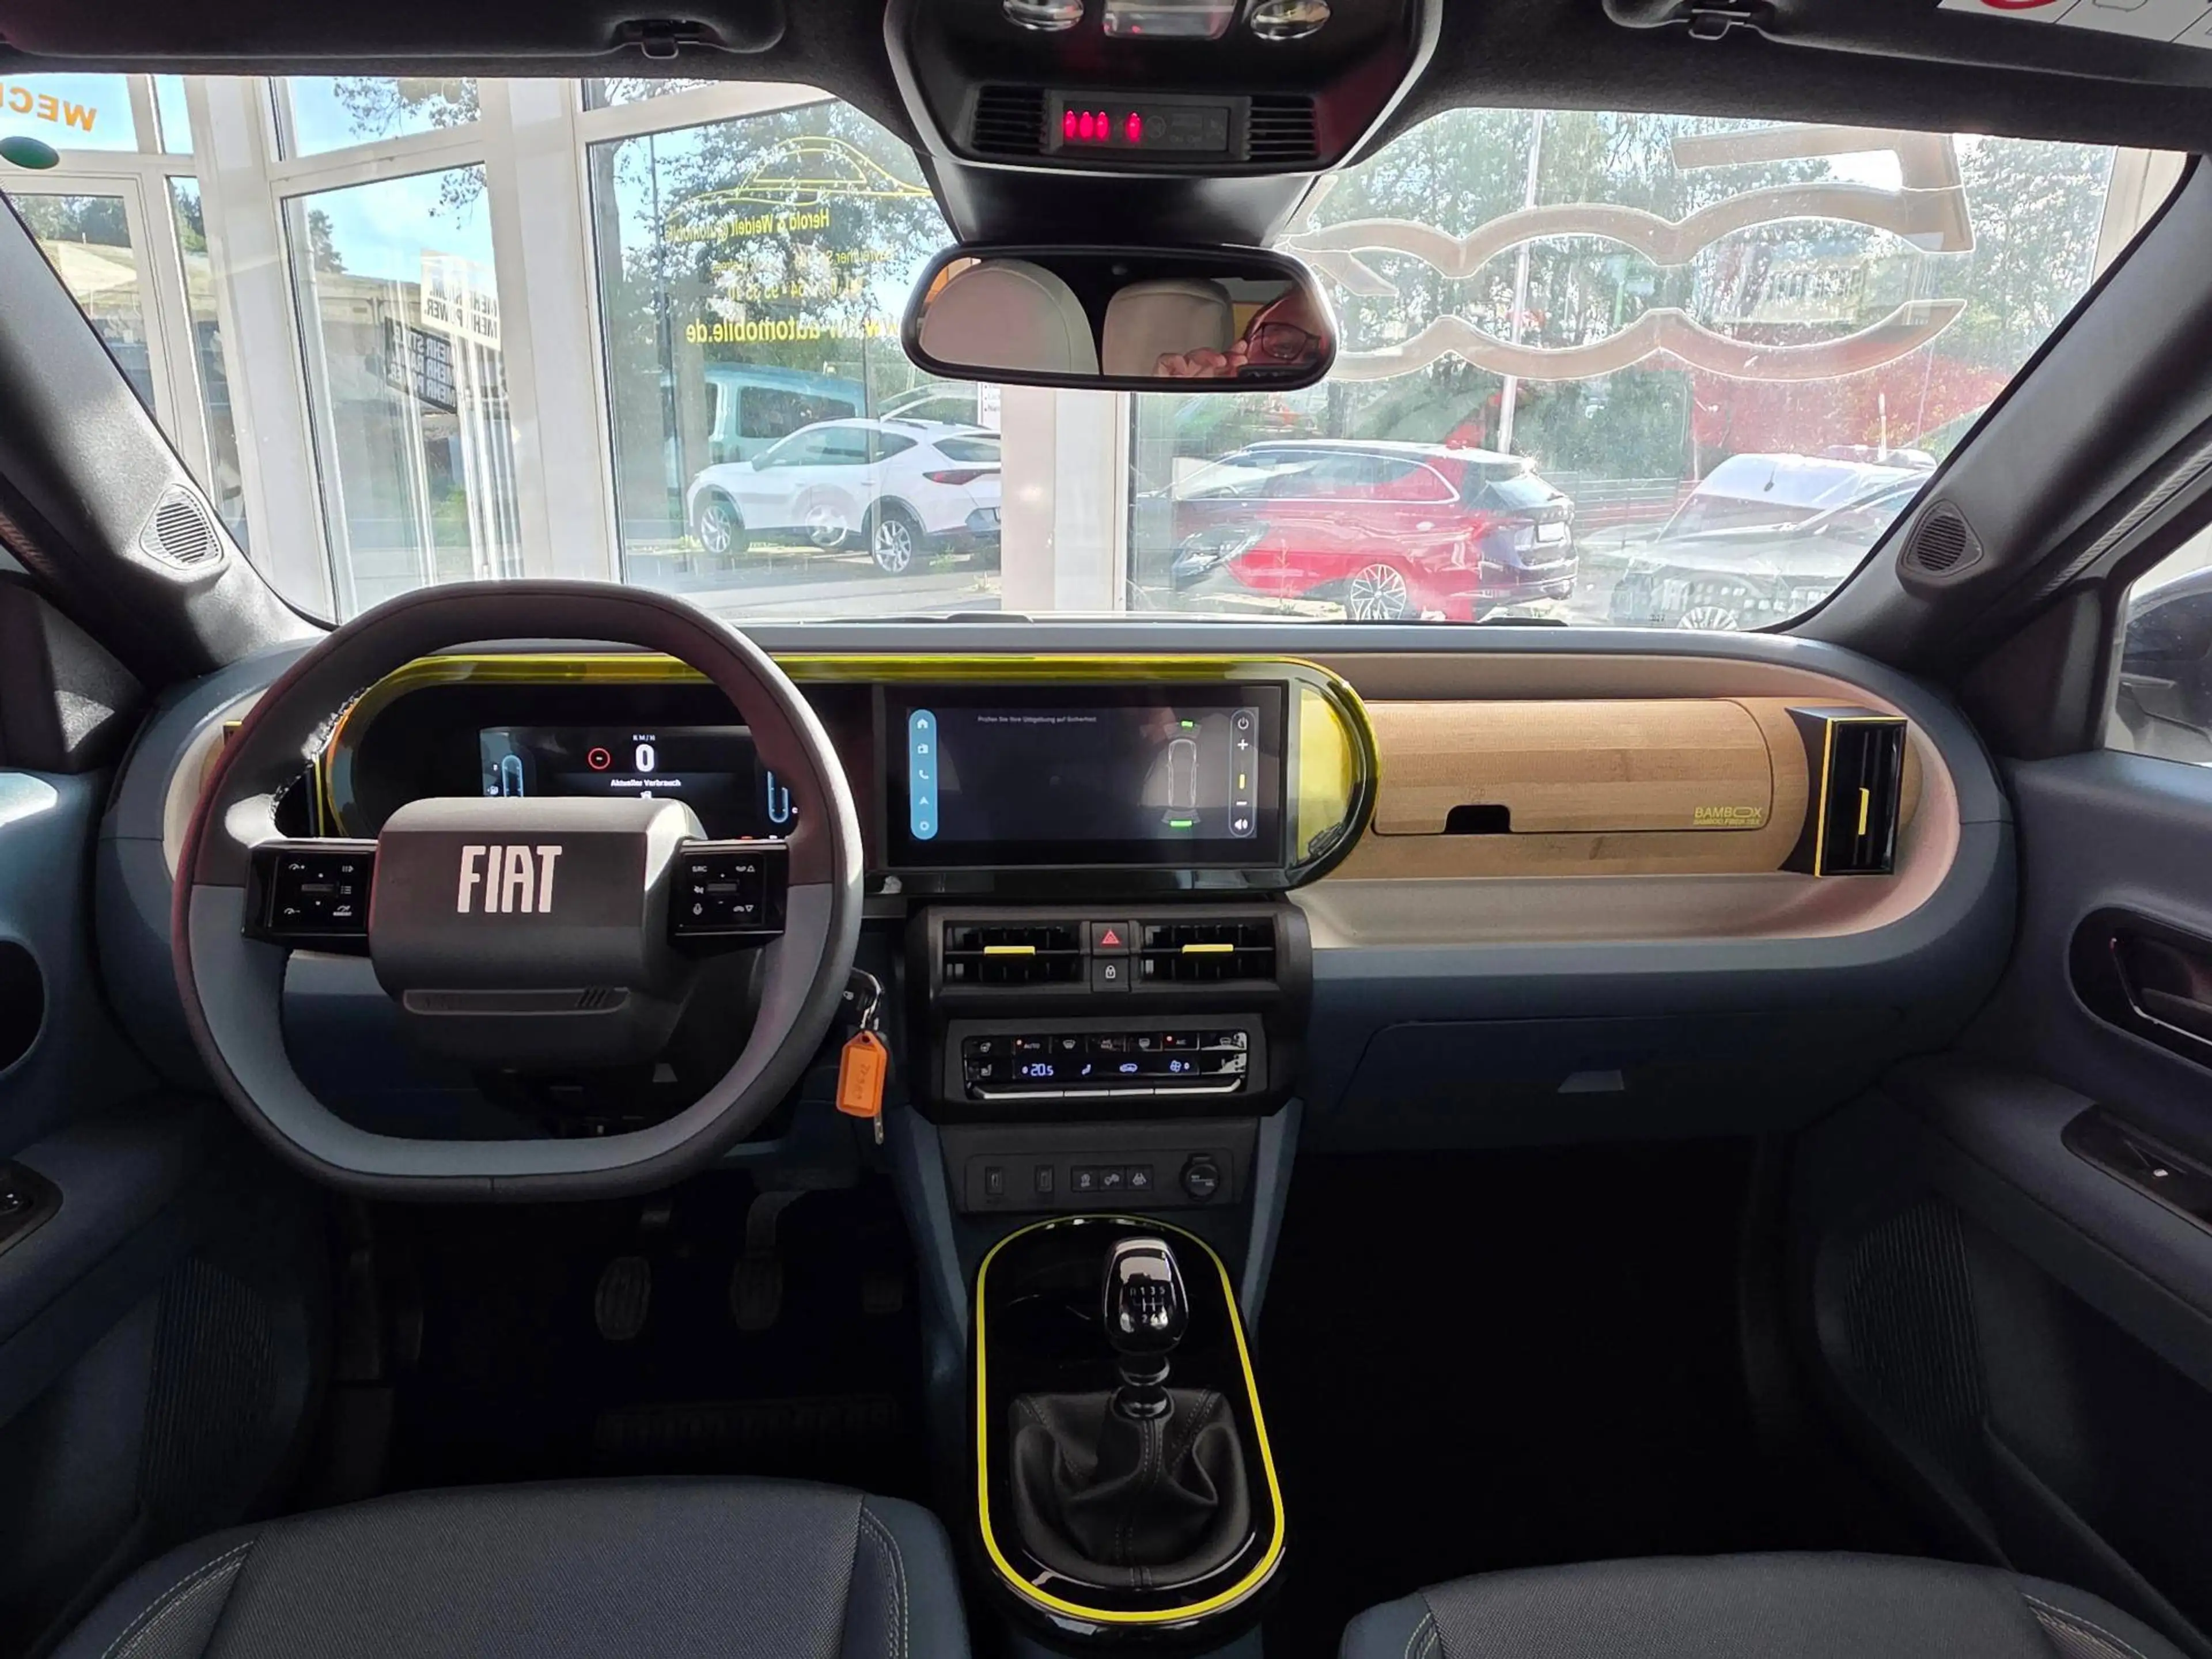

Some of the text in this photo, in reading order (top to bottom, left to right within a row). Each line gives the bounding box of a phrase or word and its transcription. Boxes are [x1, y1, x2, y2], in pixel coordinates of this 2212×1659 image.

[635, 744, 654, 772] 0
[1695, 807, 1762, 818] BAMBOX
[457, 845, 563, 912] FIAT
[1150, 1286, 1156, 1296] 3
[1159, 1286, 1166, 1295] 5
